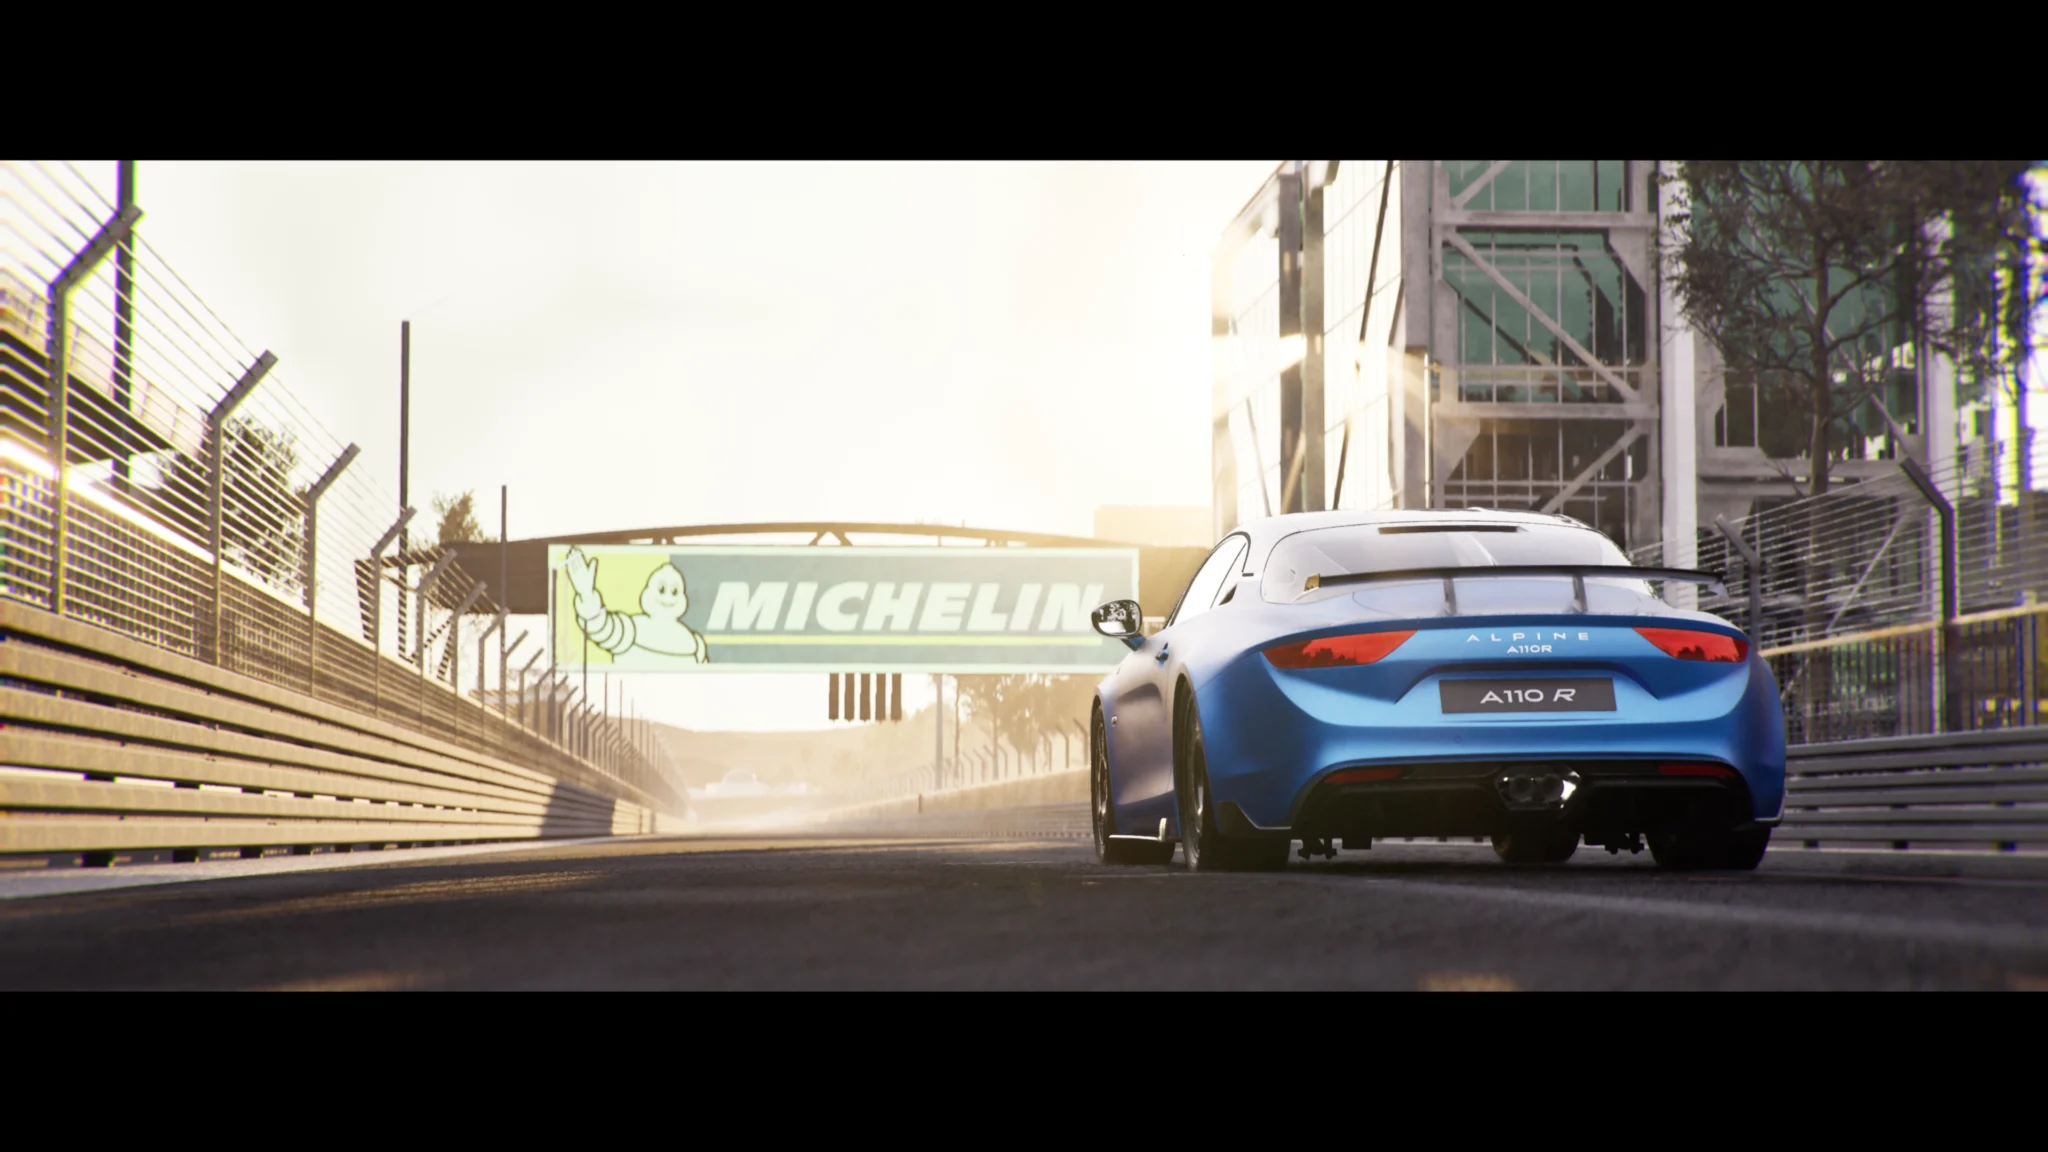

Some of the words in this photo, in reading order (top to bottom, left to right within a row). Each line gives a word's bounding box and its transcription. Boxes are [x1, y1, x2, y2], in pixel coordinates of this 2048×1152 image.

[706, 581, 1104, 632] MICHELIN
[1466, 632, 1589, 643] ALPINE
[1506, 644, 1553, 654] A110R
[1479, 688, 1545, 704] A110
[1552, 688, 1577, 702] R
